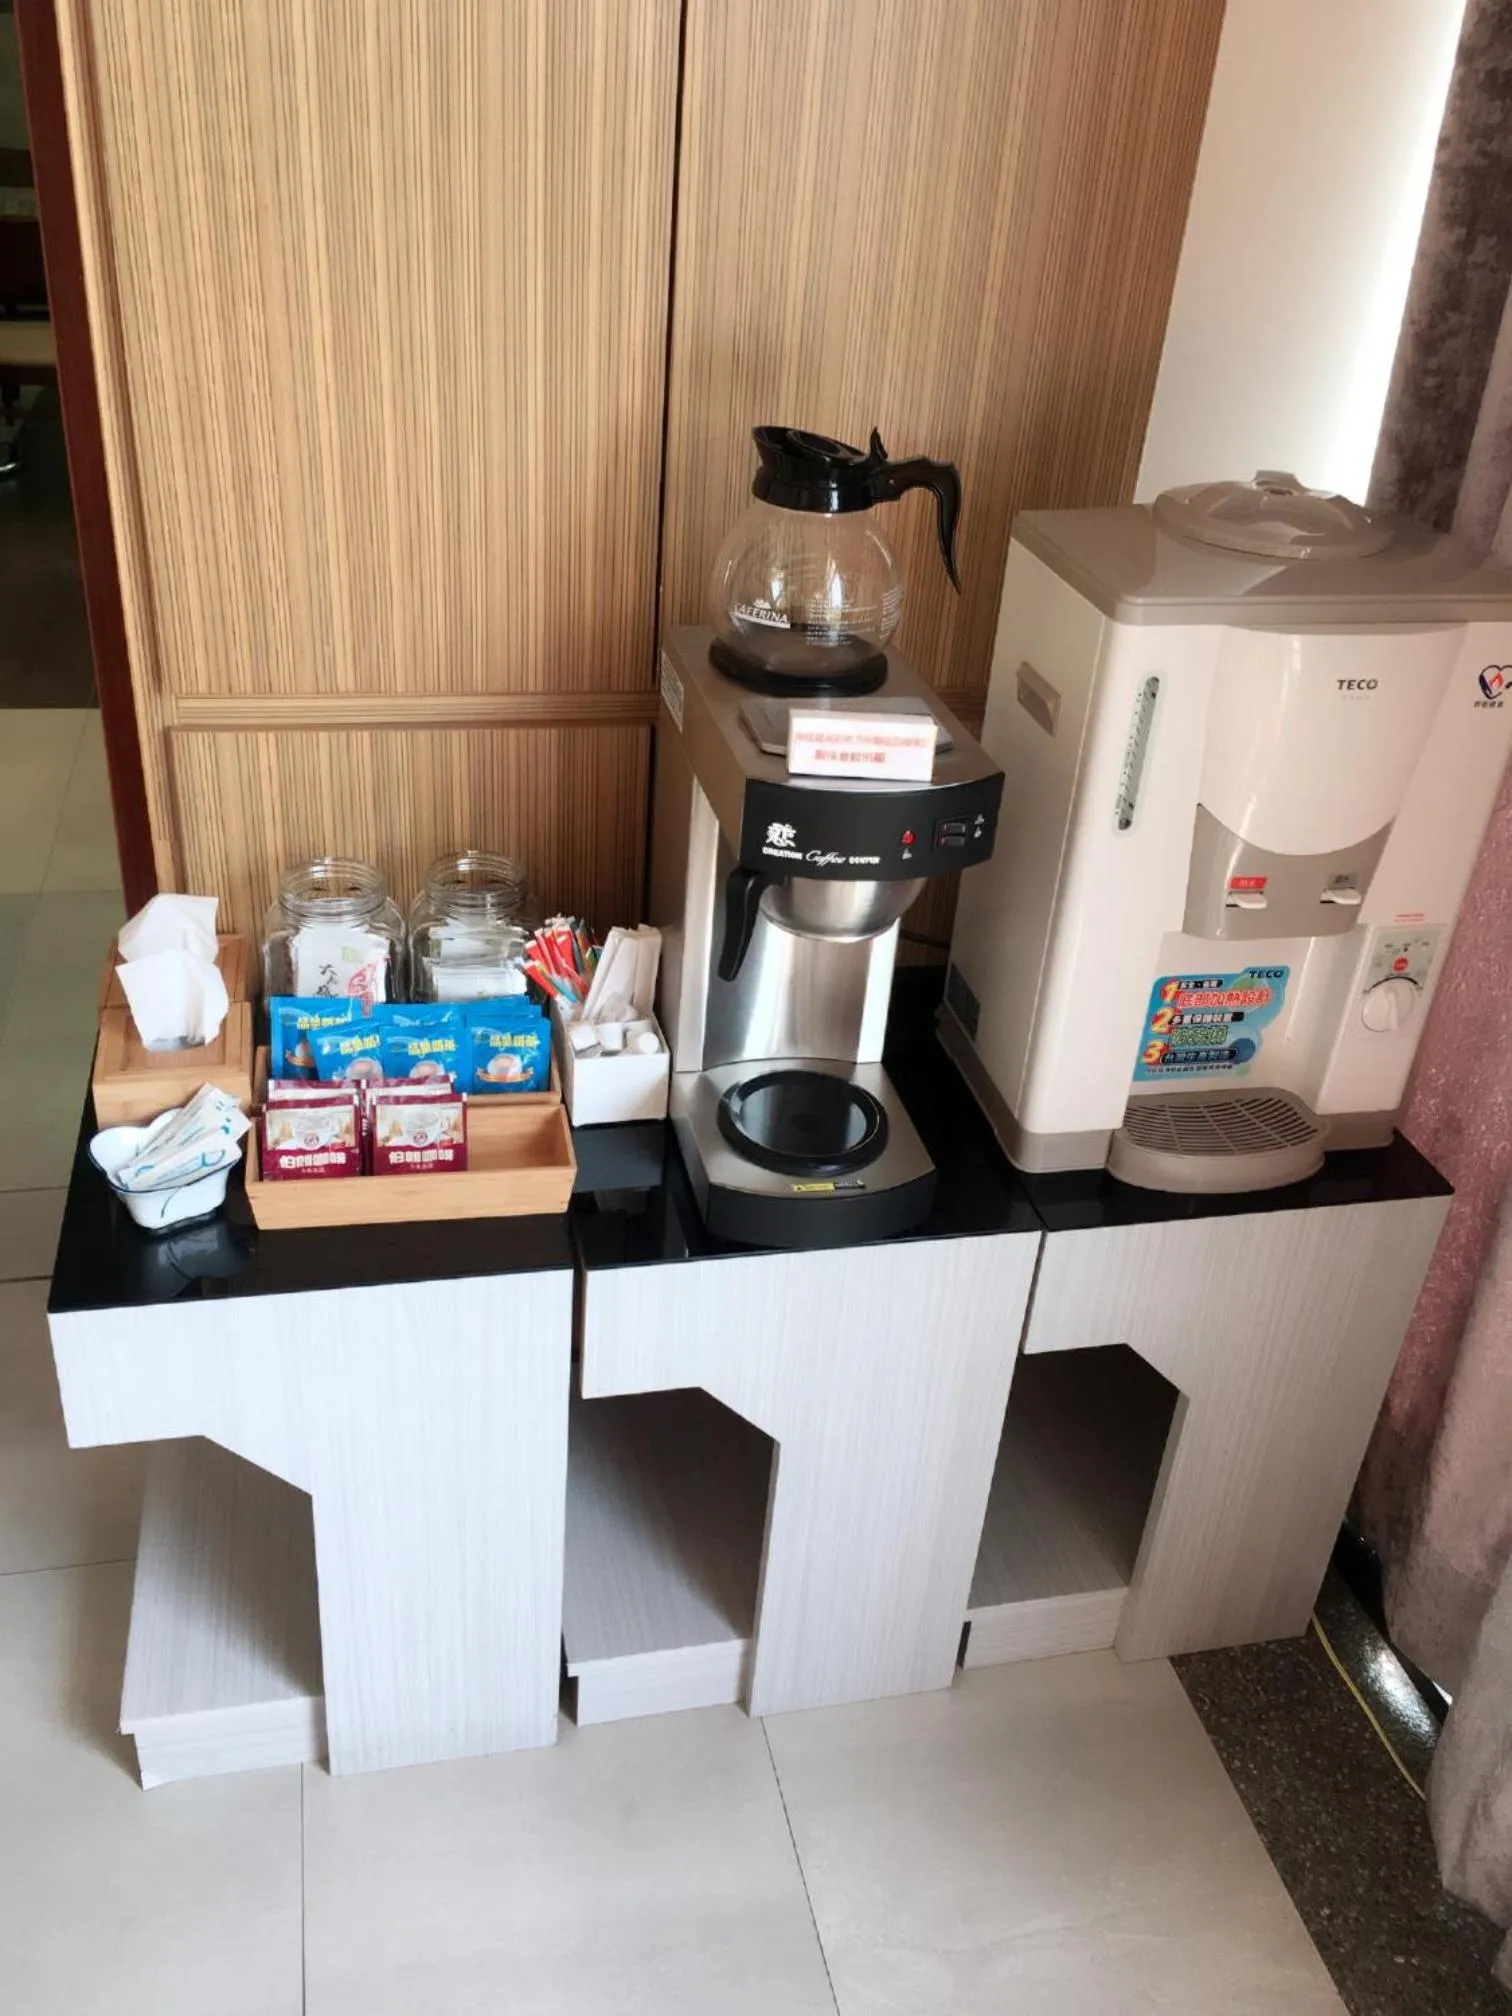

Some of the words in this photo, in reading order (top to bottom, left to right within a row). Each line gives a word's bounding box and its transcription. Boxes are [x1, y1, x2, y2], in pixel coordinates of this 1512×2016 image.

[1337, 679, 1378, 690] TECO
[762, 847, 803, 860] CREATION
[805, 850, 846, 867] Coffee
[1249, 970, 1284, 979] TECO
